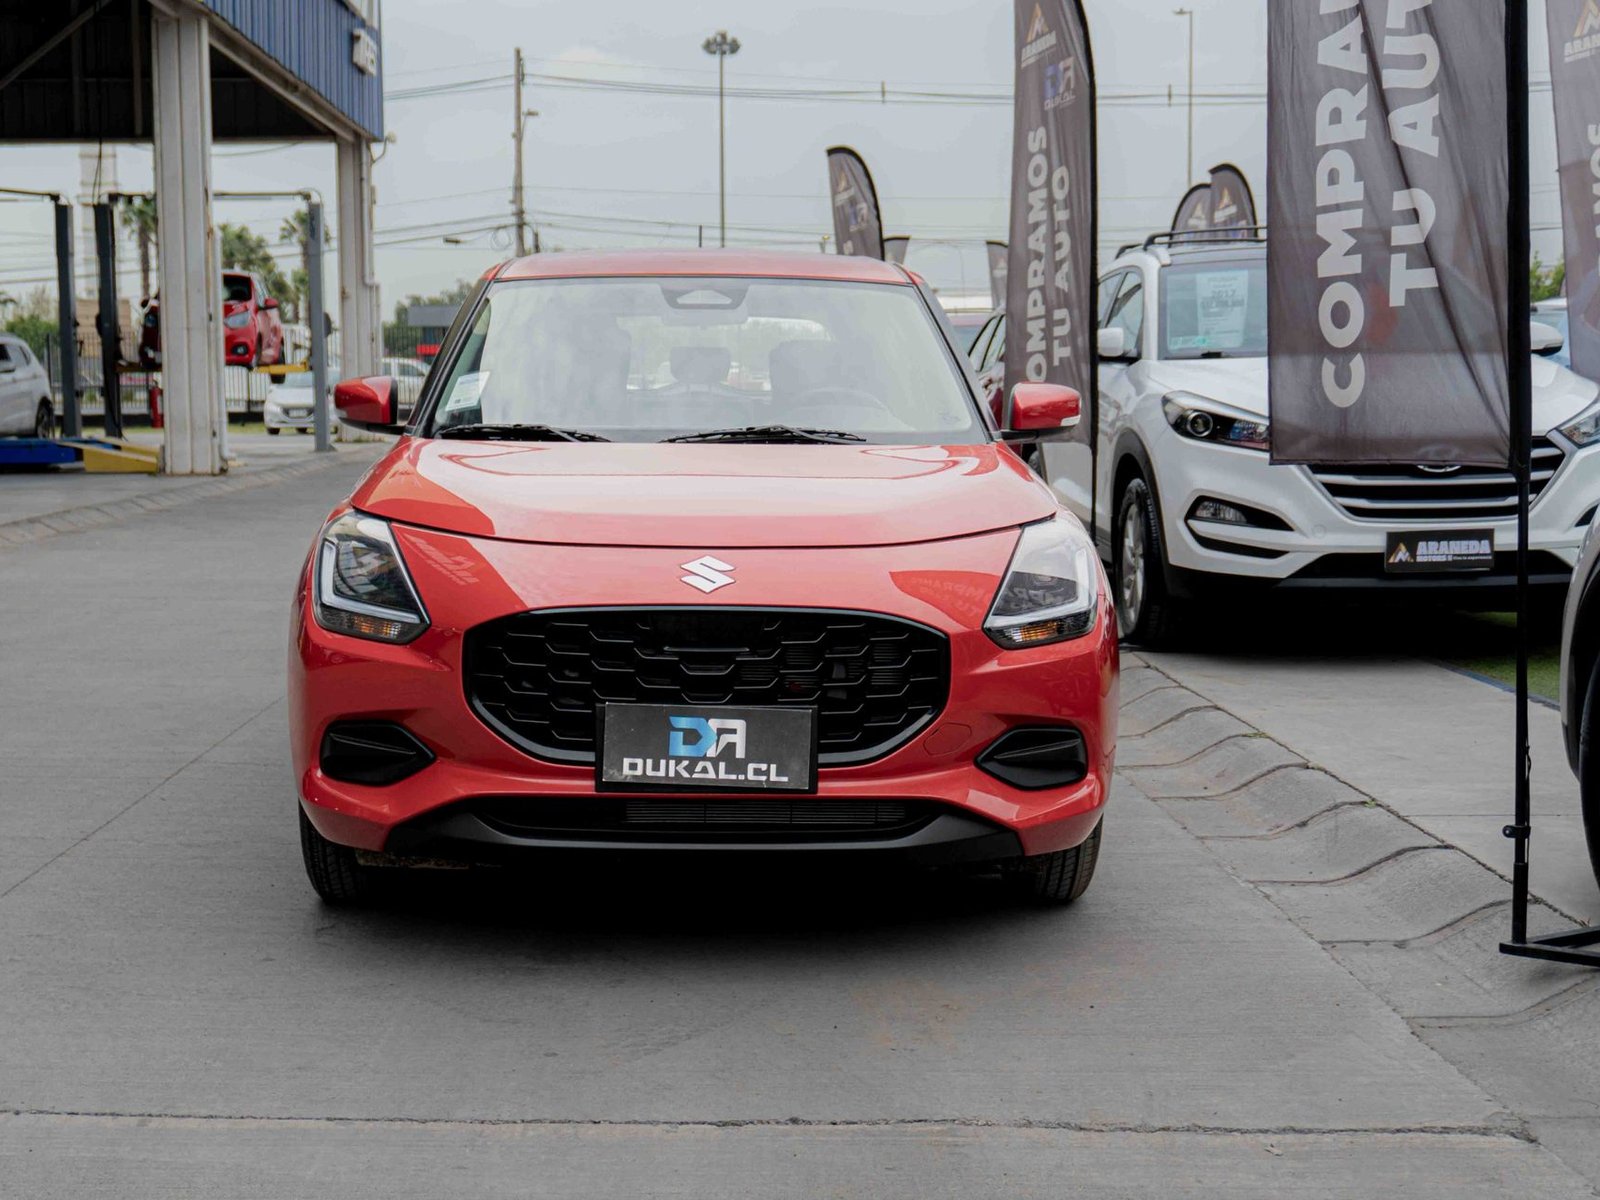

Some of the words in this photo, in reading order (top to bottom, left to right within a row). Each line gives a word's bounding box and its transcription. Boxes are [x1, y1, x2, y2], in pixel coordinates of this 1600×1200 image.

[1026, 125, 1048, 382] OMPRAMOS
[1052, 165, 1072, 293] AUTO
[1315, 0, 1369, 408] COMPRA
[1389, 187, 1441, 308] TU
[1052, 308, 1072, 366] TU
[1416, 540, 1491, 555] ARANEDA
[622, 757, 789, 782] DUKAL.CL
